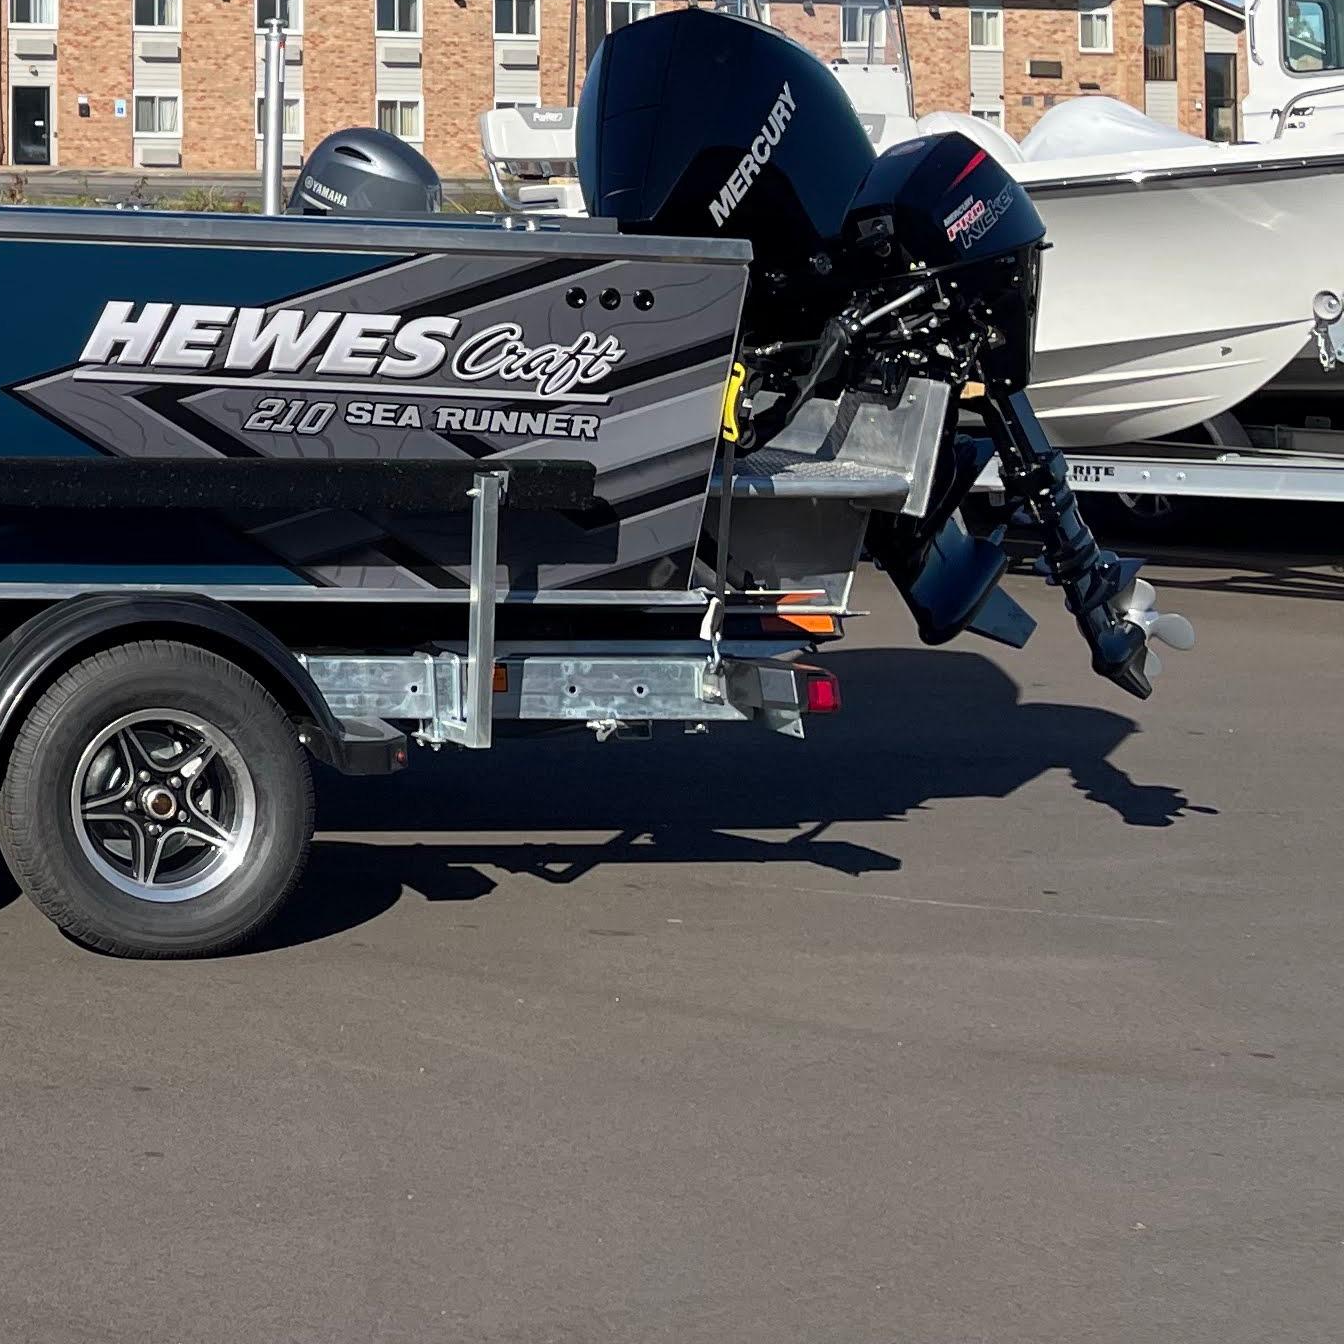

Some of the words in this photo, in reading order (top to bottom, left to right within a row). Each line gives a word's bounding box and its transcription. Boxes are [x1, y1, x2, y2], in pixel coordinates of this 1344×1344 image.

[709, 81, 796, 227] MERCURY
[313, 181, 348, 207] YAMAHA
[78, 301, 461, 378] HEWES
[453, 322, 626, 397] Craft
[244, 398, 337, 434] 210
[345, 402, 422, 429] SEA
[436, 406, 600, 439] RUNNER
[1073, 465, 1115, 476] RITE
